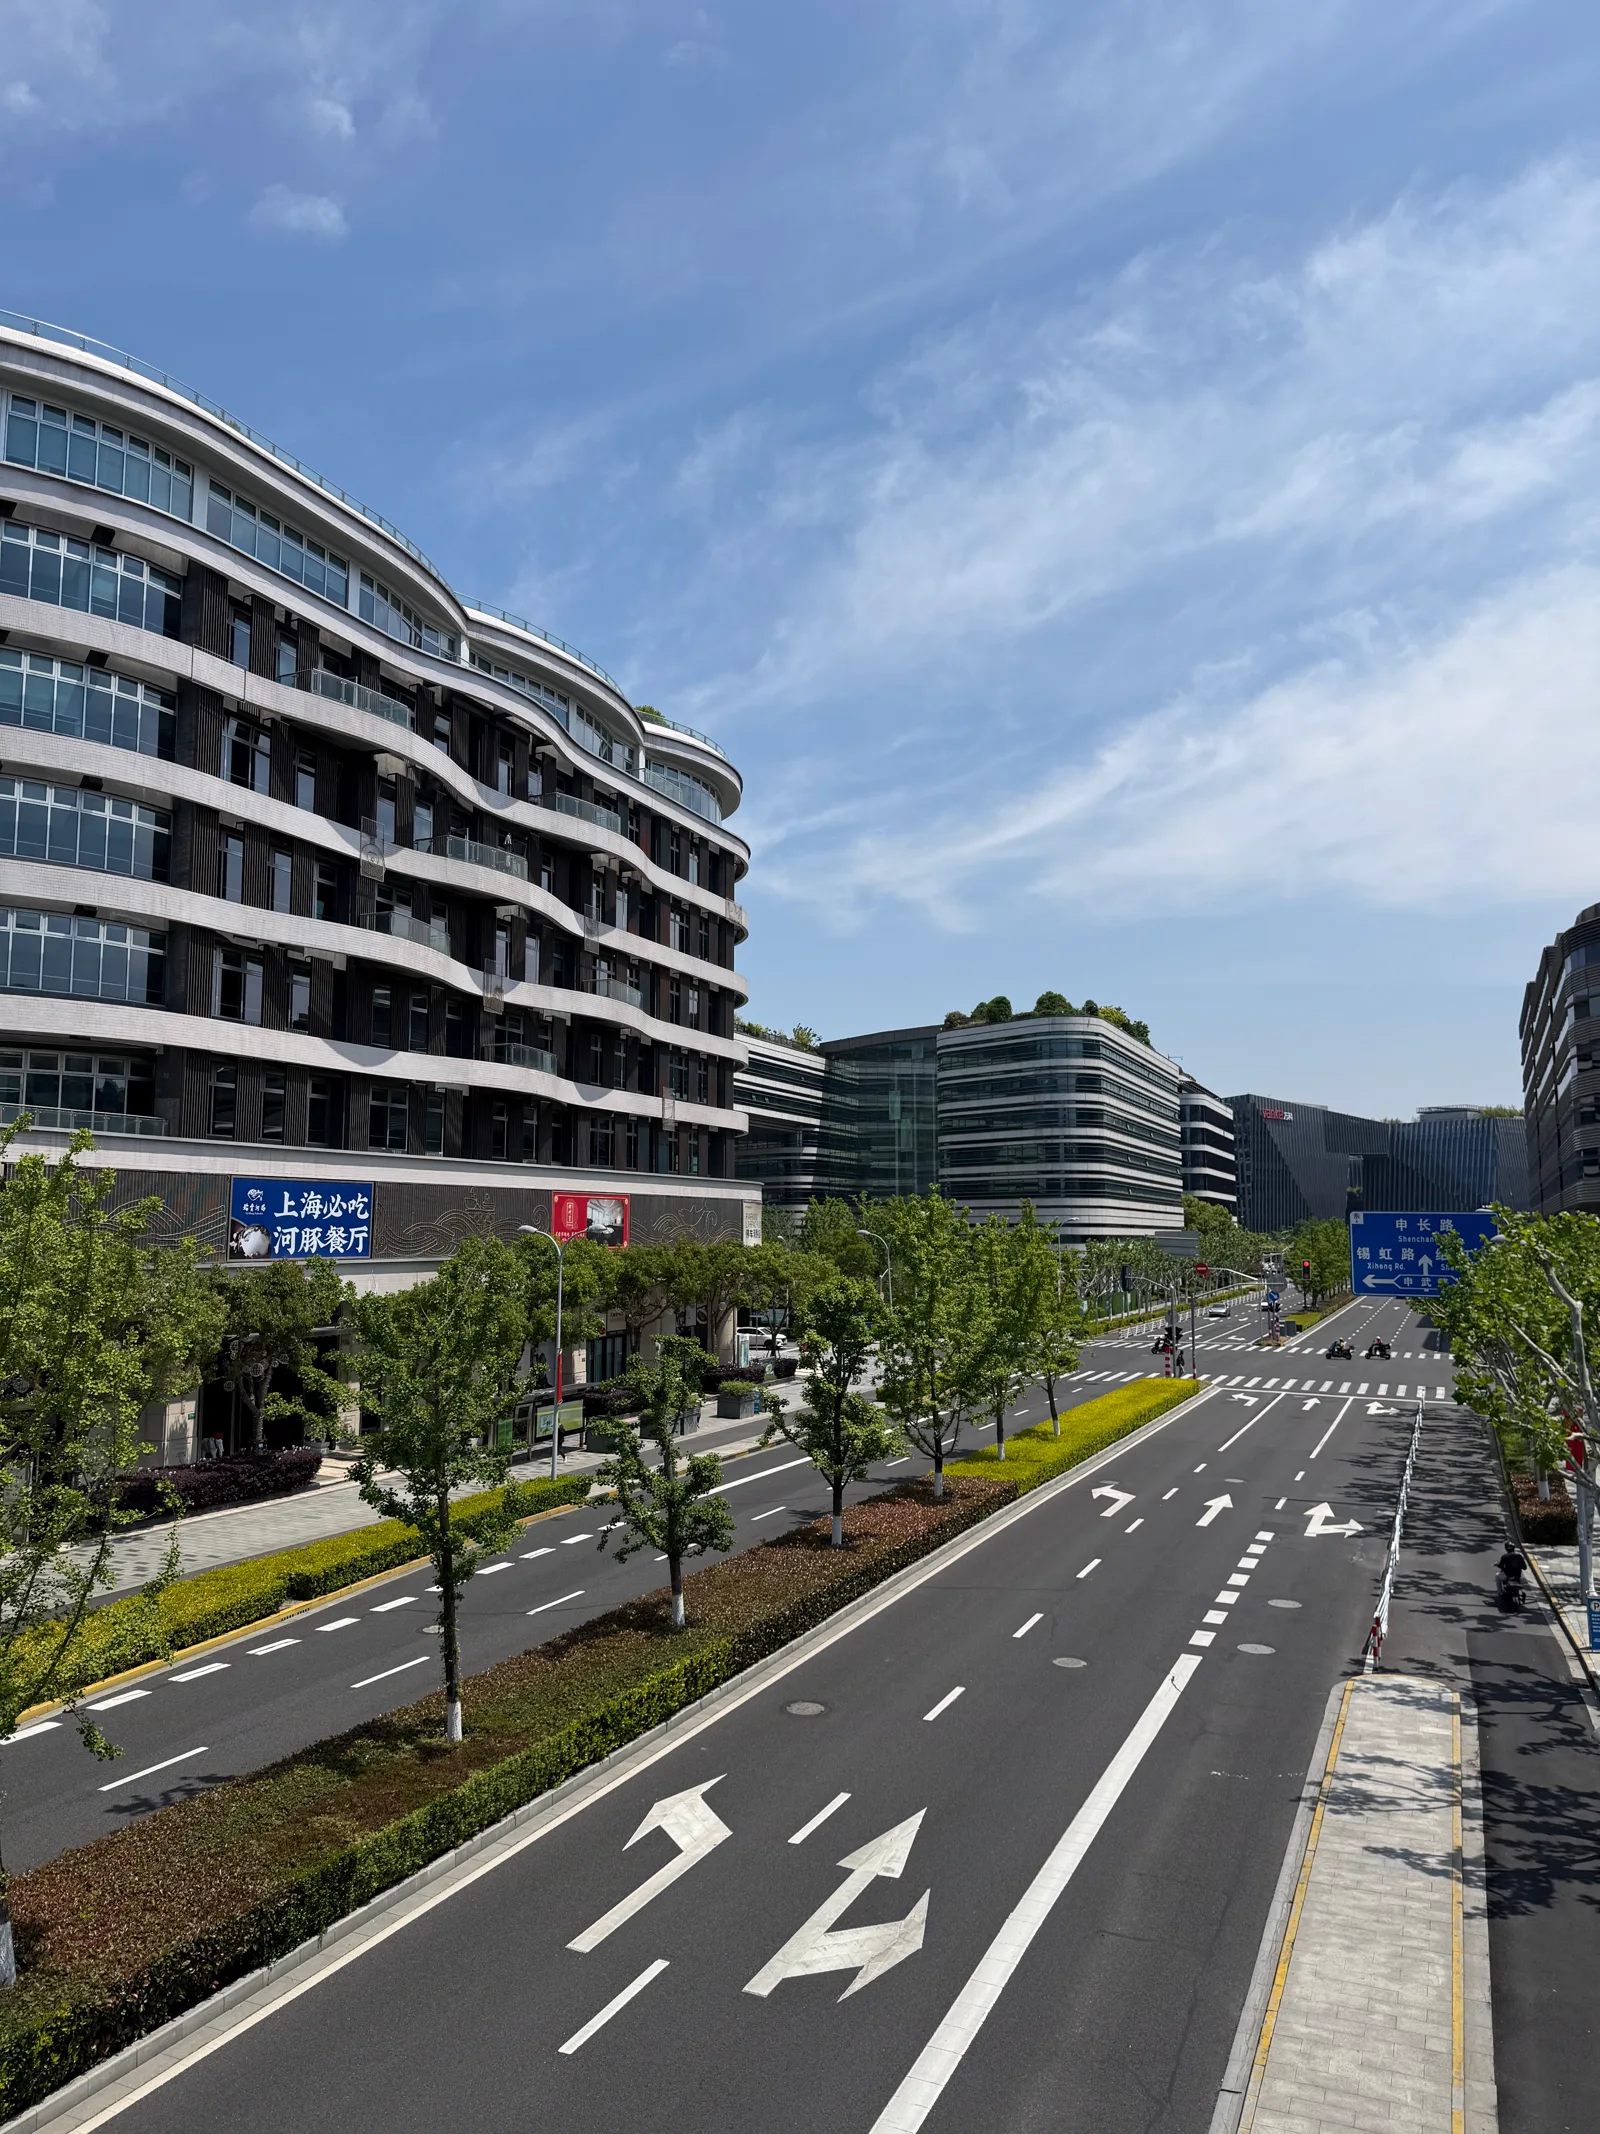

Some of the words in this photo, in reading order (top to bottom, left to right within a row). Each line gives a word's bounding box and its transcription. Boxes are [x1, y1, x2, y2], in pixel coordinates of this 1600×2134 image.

[273, 1191, 369, 1220] 上海必吃
[1396, 1218, 1454, 1232] 申长路
[273, 1225, 369, 1255] 河豚餐厅
[1356, 1247, 1415, 1260] 锡虹路
[1367, 1262, 1393, 1272] Xihong
